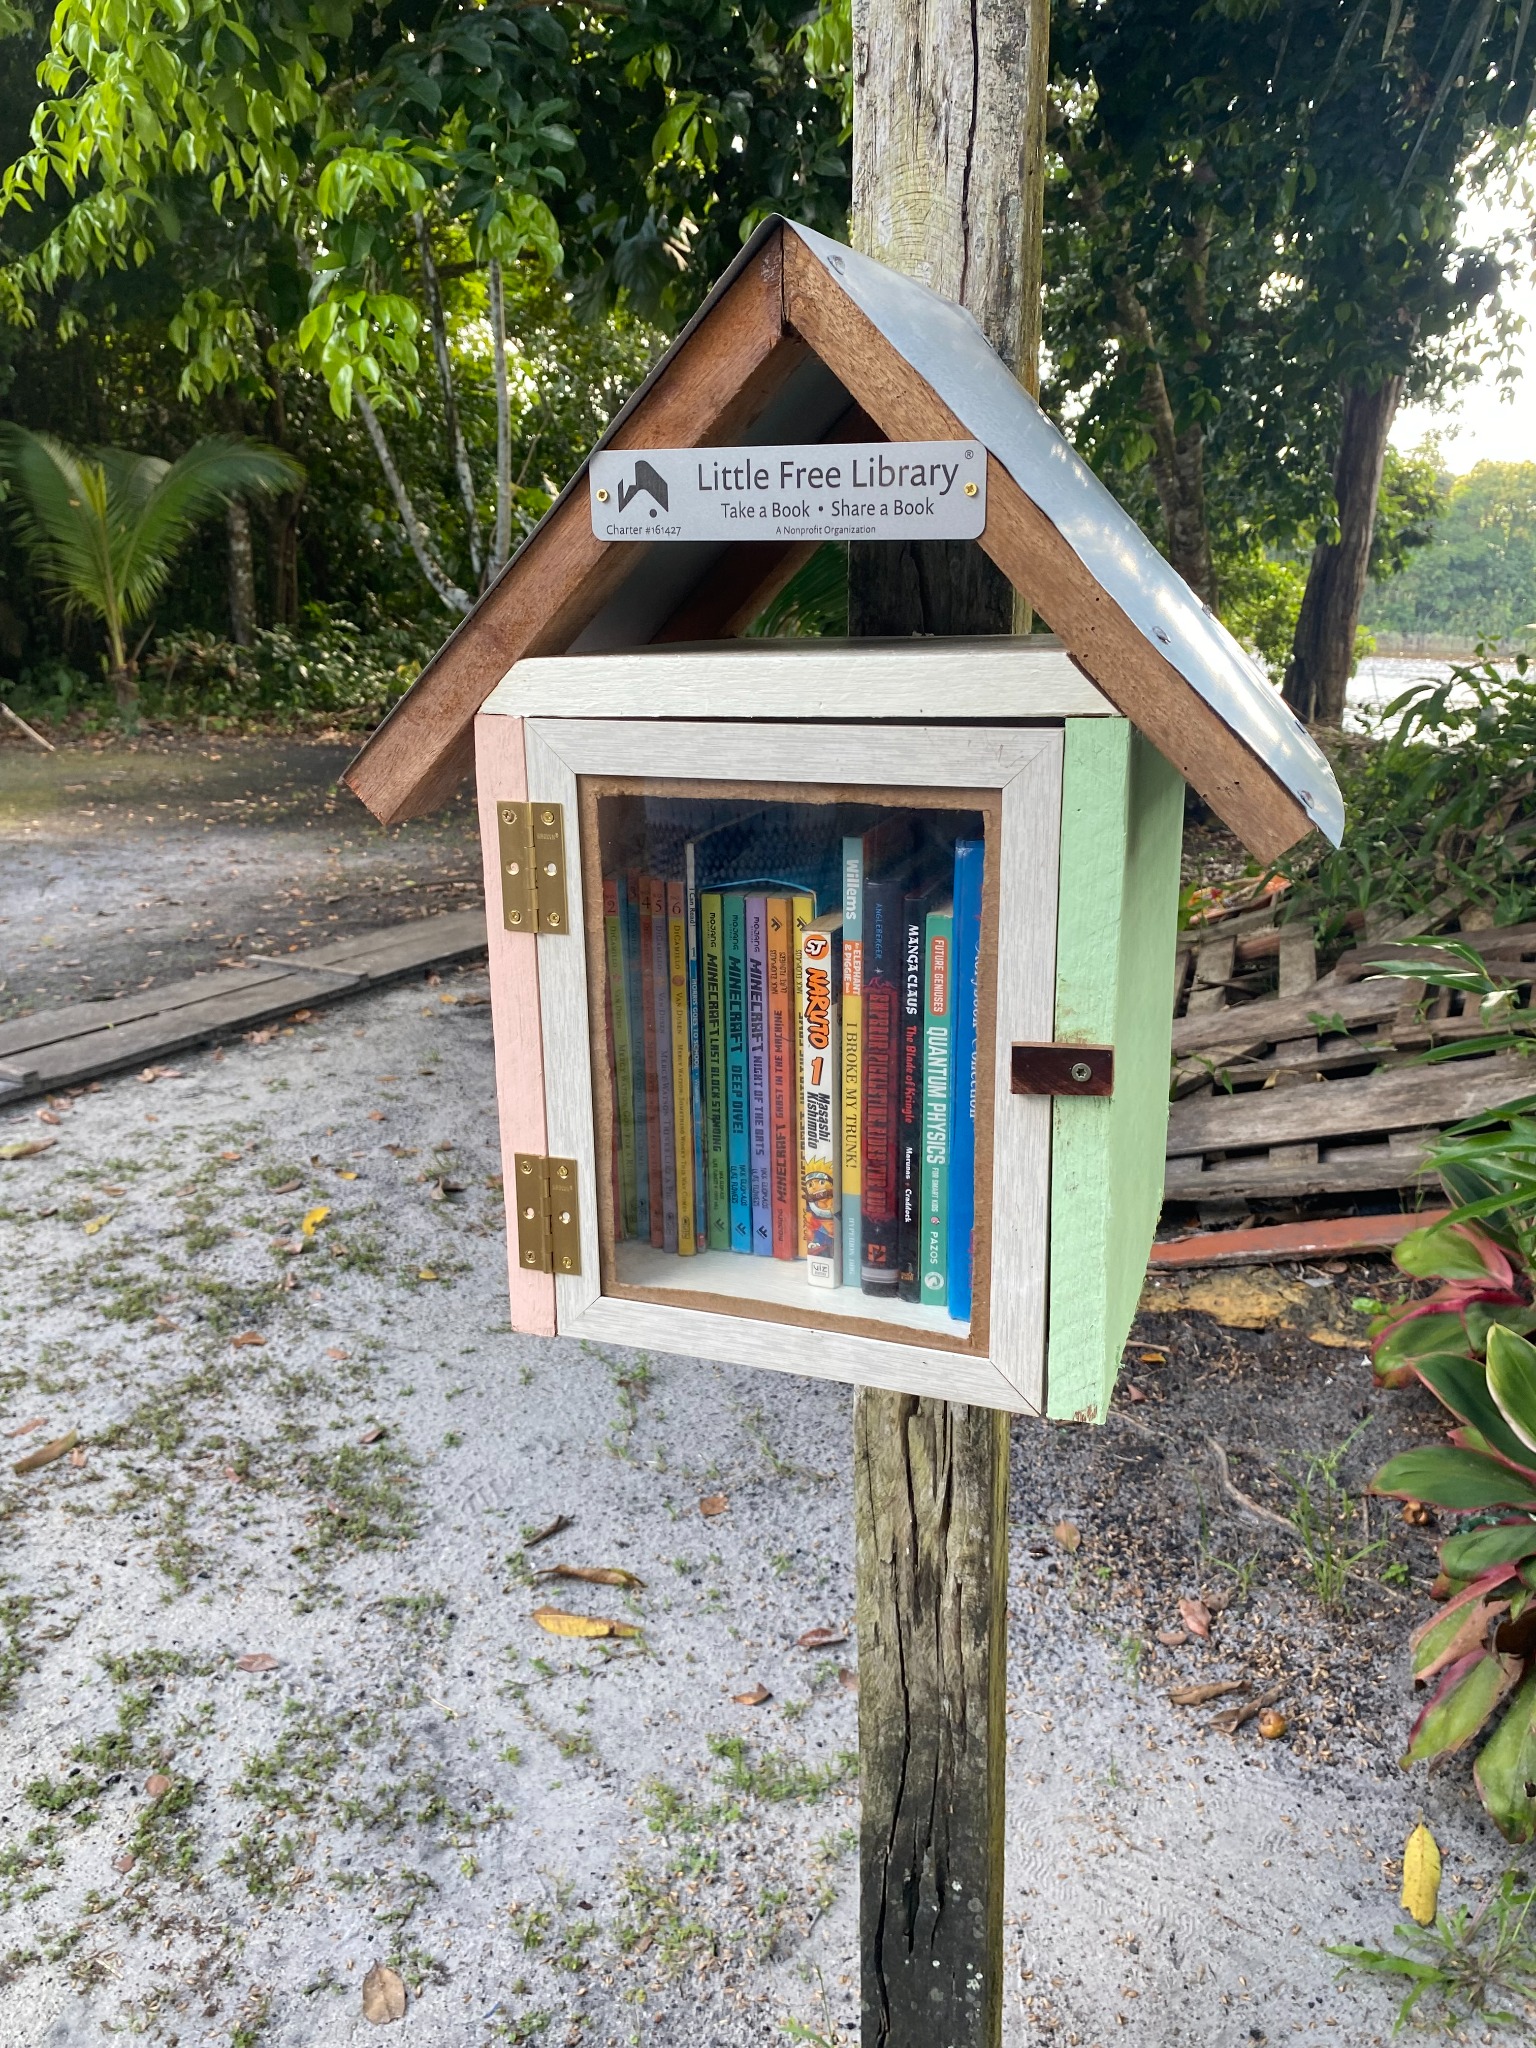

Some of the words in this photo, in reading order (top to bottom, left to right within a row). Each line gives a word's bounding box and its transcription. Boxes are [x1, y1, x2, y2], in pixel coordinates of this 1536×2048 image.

[698, 458, 770, 491] Little
[780, 460, 841, 490] Free
[853, 454, 959, 496] Library
[721, 502, 756, 519] Take
[759, 507, 768, 518] a
[772, 501, 810, 518] Book
[831, 501, 877, 517] Share
[880, 505, 889, 516] a
[893, 499, 935, 516] Book
[606, 524, 643, 536] Charter
[645, 524, 682, 537] #161427
[775, 525, 782, 534] A
[783, 525, 823, 536] Nonprofit
[824, 524, 876, 536] Organization
[845, 859, 860, 920] Willems
[607, 901, 616, 913] 2
[655, 900, 662, 913] 5
[672, 902, 681, 914] 6
[874, 903, 884, 960] ANGLEBERGER
[906, 923, 919, 972] MANGA
[844, 952, 852, 982] PIGGIE
[933, 939, 945, 971] FUTURE
[852, 949, 861, 996] ELEPHANT
[706, 953, 718, 1035] MINECRAFT
[728, 955, 742, 1052] MINECRAFT
[750, 957, 763, 1052] MINECRAFT
[805, 967, 831, 1049] NARUTO
[905, 974, 918, 1015] CLAUS
[933, 973, 944, 1013] GENIUSES
[693, 1028, 699, 1038] TO
[773, 1010, 783, 1053] MACHINE
[906, 1025, 917, 1042] The
[710, 1038, 719, 1062] LAST
[774, 1055, 782, 1073] THE
[846, 1032, 858, 1083] BROKE
[905, 1045, 917, 1073] Blade
[926, 1026, 948, 1098] QUANTUM
[711, 1067, 721, 1099] BLOCK
[731, 1065, 742, 1097] DEEP
[753, 1055, 763, 1087] NIGHT
[774, 1075, 783, 1086] IN
[811, 1056, 824, 1086] 1
[903, 1074, 916, 1086] of
[754, 1090, 764, 1103] OF
[845, 1088, 857, 1109] MY
[901, 1086, 916, 1123] Kringle
[711, 1100, 721, 1152] STANDING
[733, 1100, 744, 1134] DIVE!
[755, 1106, 765, 1126] THE
[806, 1091, 819, 1150] Kishimoto
[818, 1092, 831, 1142] Masashi
[845, 1113, 857, 1169] TRUNK!
[926, 1102, 947, 1164] PHYSICS
[775, 1124, 787, 1203] MINECRAFT
[867, 1165, 887, 1187] THE
[931, 1167, 940, 1178] FOR
[931, 1179, 940, 1197] SMART
[904, 1188, 913, 1223] Craddock
[931, 1199, 939, 1212] KIDS
[930, 1231, 938, 1264] PAZOS
